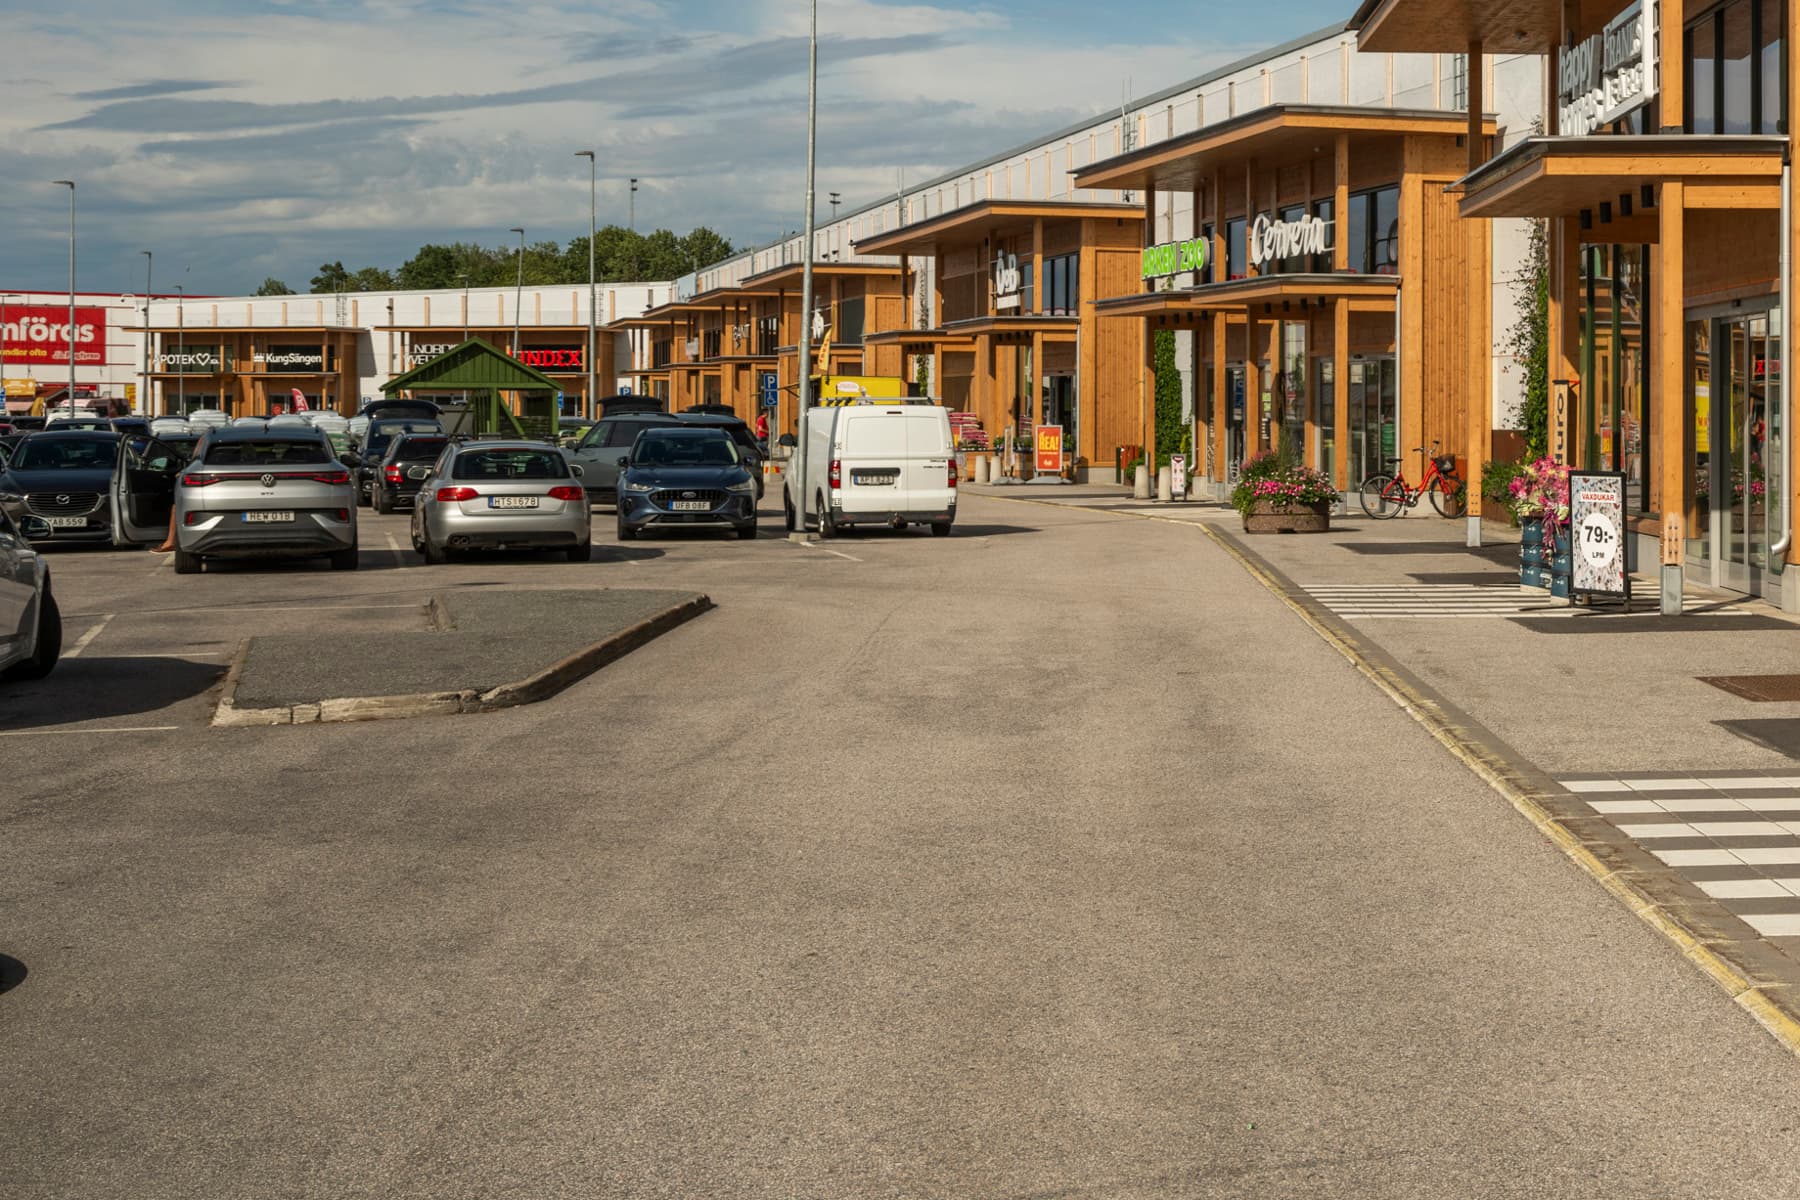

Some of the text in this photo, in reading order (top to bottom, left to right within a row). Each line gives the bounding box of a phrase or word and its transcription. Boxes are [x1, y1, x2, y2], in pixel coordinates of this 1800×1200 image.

[1251, 213, 1325, 265] Cervera
[1180, 237, 1205, 271] ZOO
[414, 343, 461, 354] NORDI
[510, 349, 580, 367] INDEX
